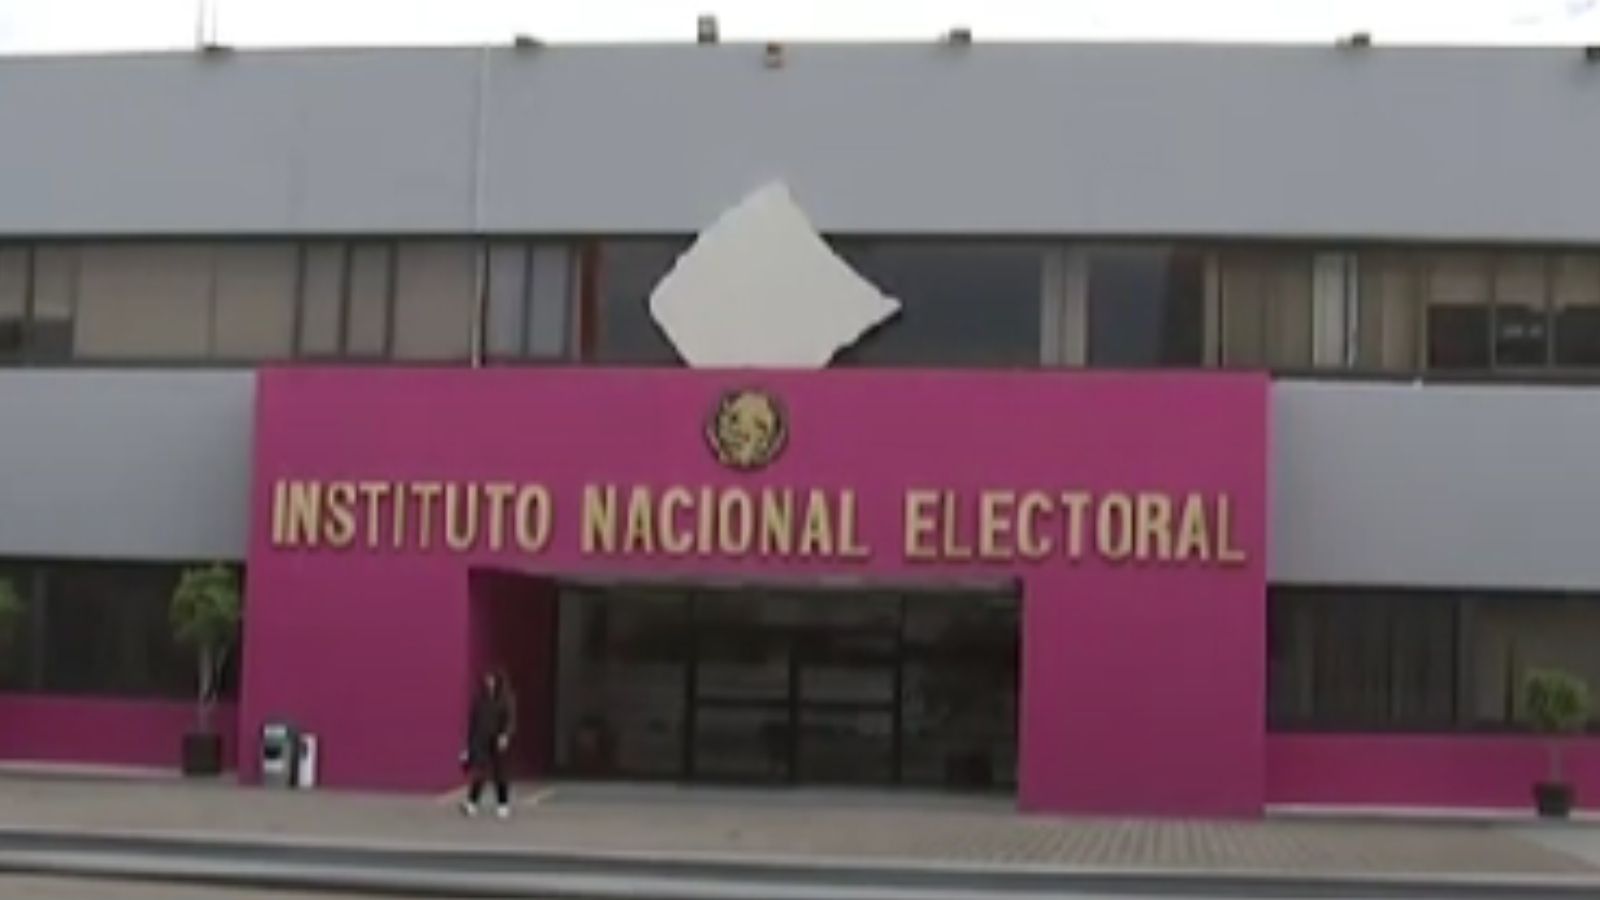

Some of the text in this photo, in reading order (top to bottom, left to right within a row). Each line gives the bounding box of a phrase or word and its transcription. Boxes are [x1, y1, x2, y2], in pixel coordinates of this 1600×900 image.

[271, 479, 1246, 563] INSTITUTO NACIONAL ELECTORAL
